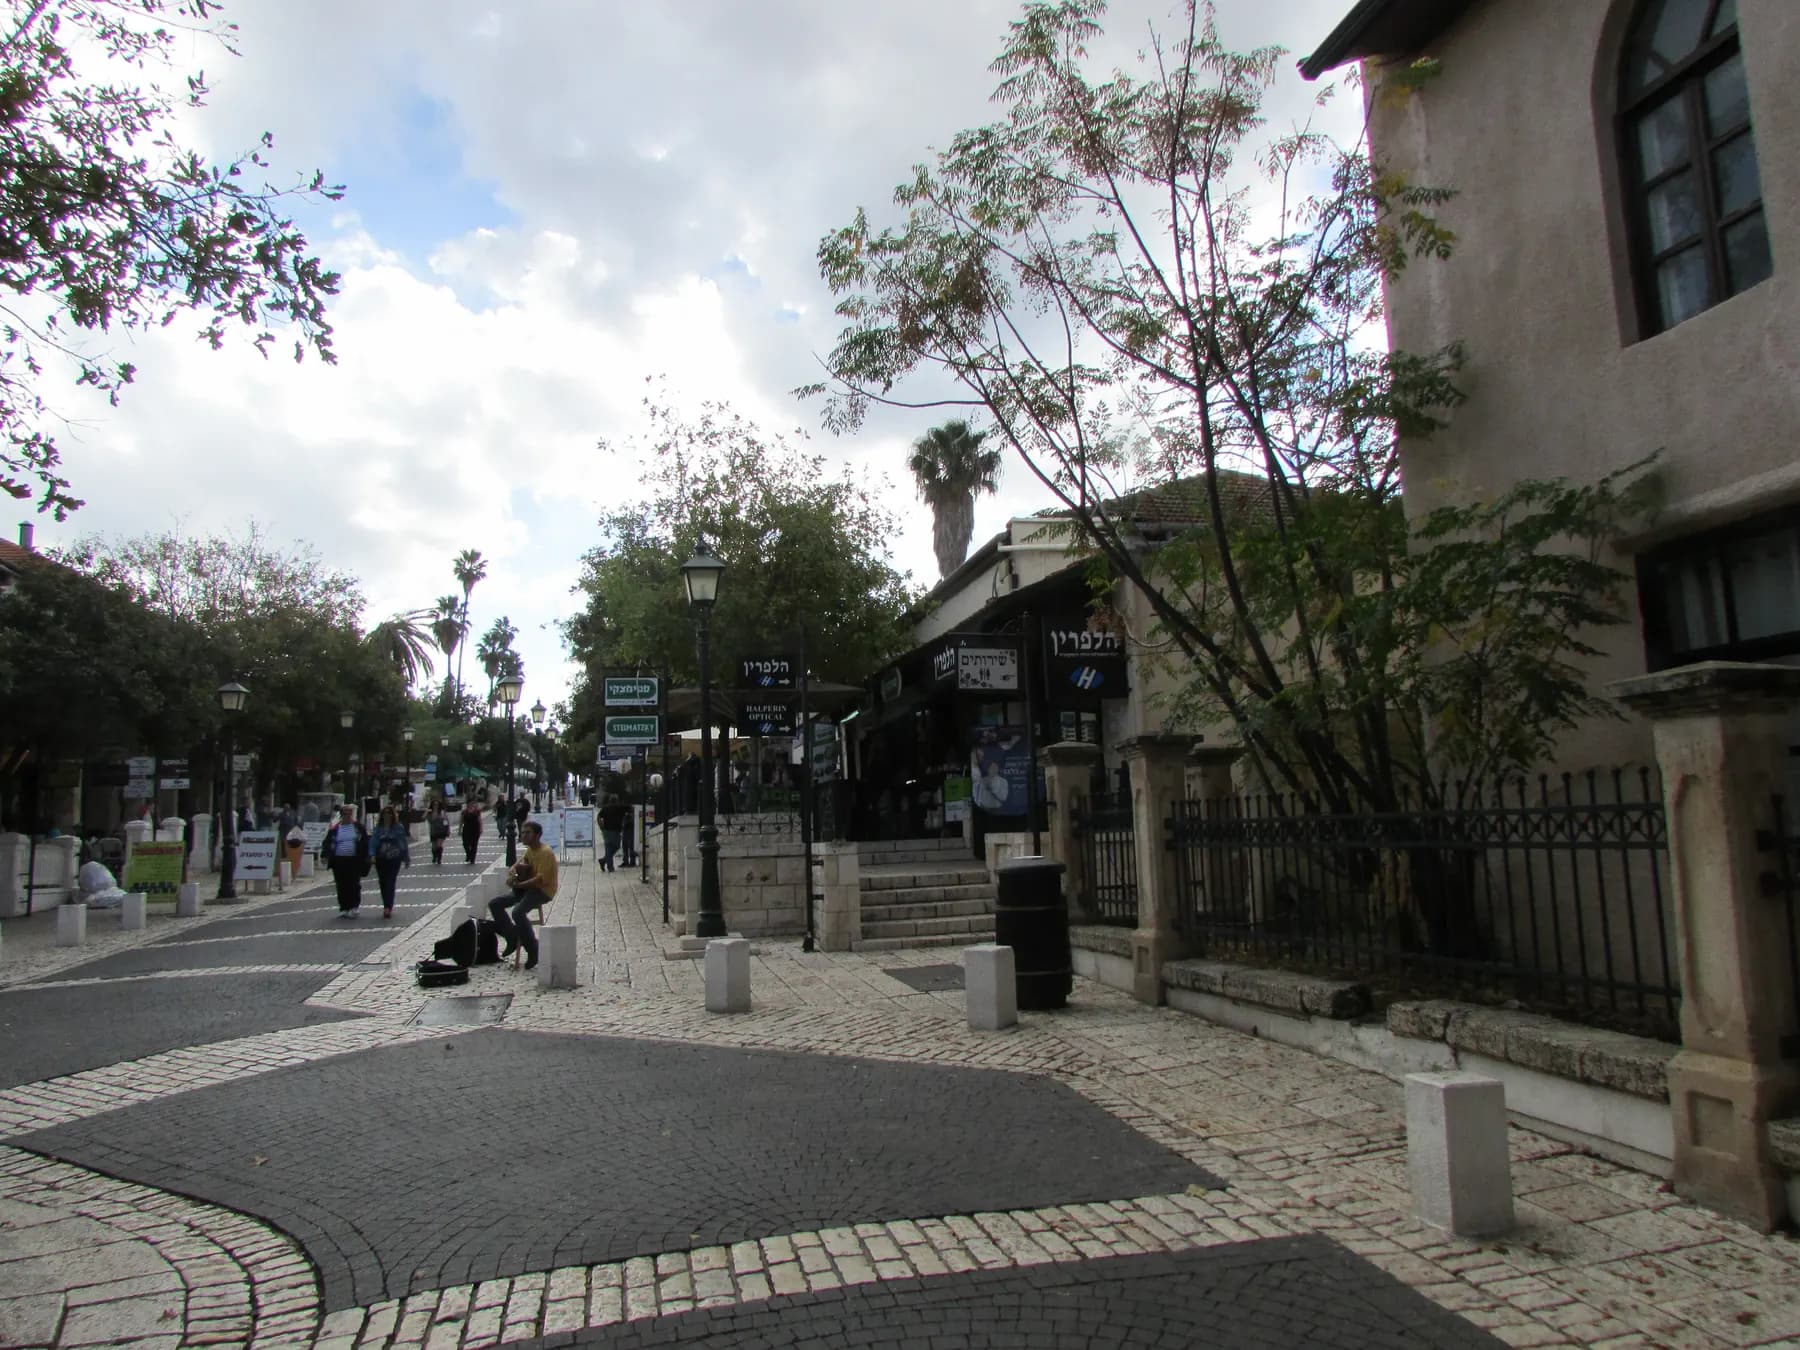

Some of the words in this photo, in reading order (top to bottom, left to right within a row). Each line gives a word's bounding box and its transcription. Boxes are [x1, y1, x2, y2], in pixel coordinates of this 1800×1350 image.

[1050, 629, 1118, 657] הלפרין
[961, 654, 1008, 666] שירותים
[743, 658, 789, 677] הלפרין
[746, 705, 788, 713] HALPERIN
[748, 713, 785, 721] OPTICAL
[612, 723, 655, 732] STEIMATZKY
